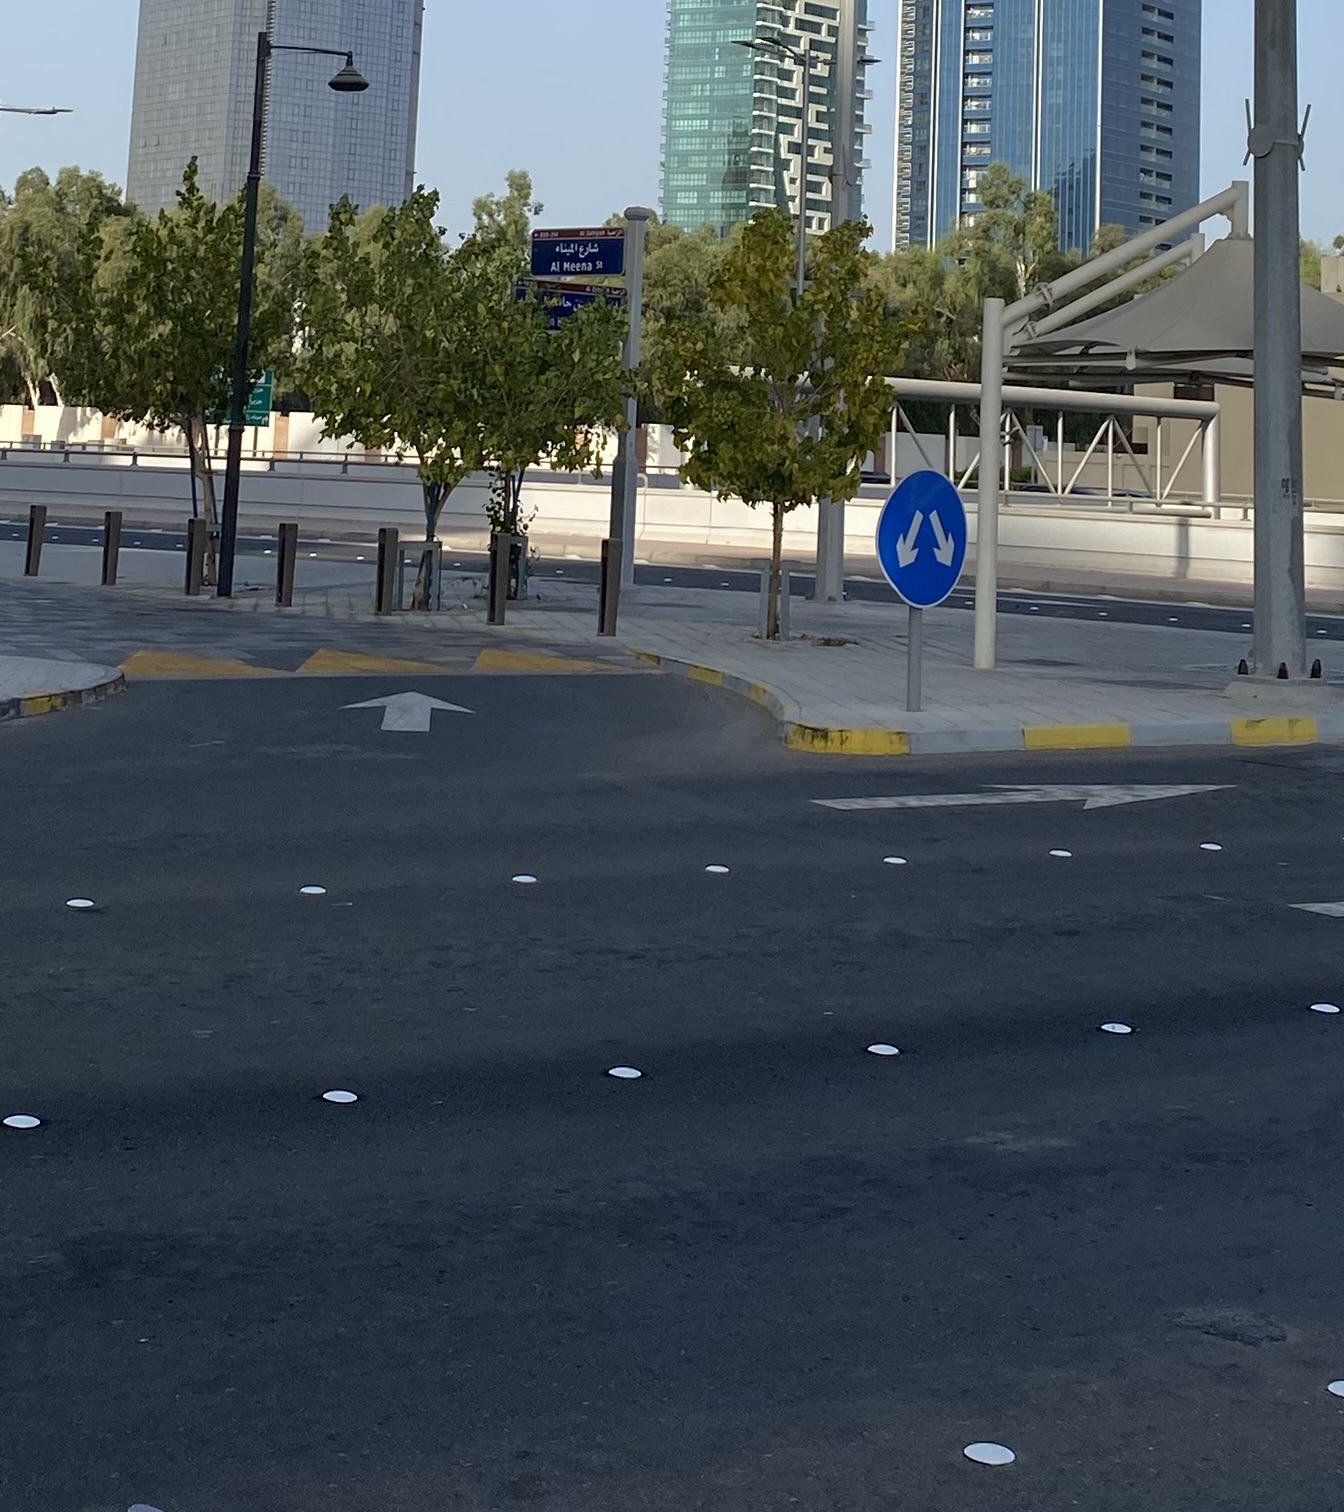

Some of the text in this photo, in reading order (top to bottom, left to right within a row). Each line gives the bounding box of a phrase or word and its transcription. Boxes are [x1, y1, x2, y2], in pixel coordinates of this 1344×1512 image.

[555, 242, 599, 258] شارع الميناء
[550, 261, 560, 272] Al
[563, 262, 593, 272] Meena
